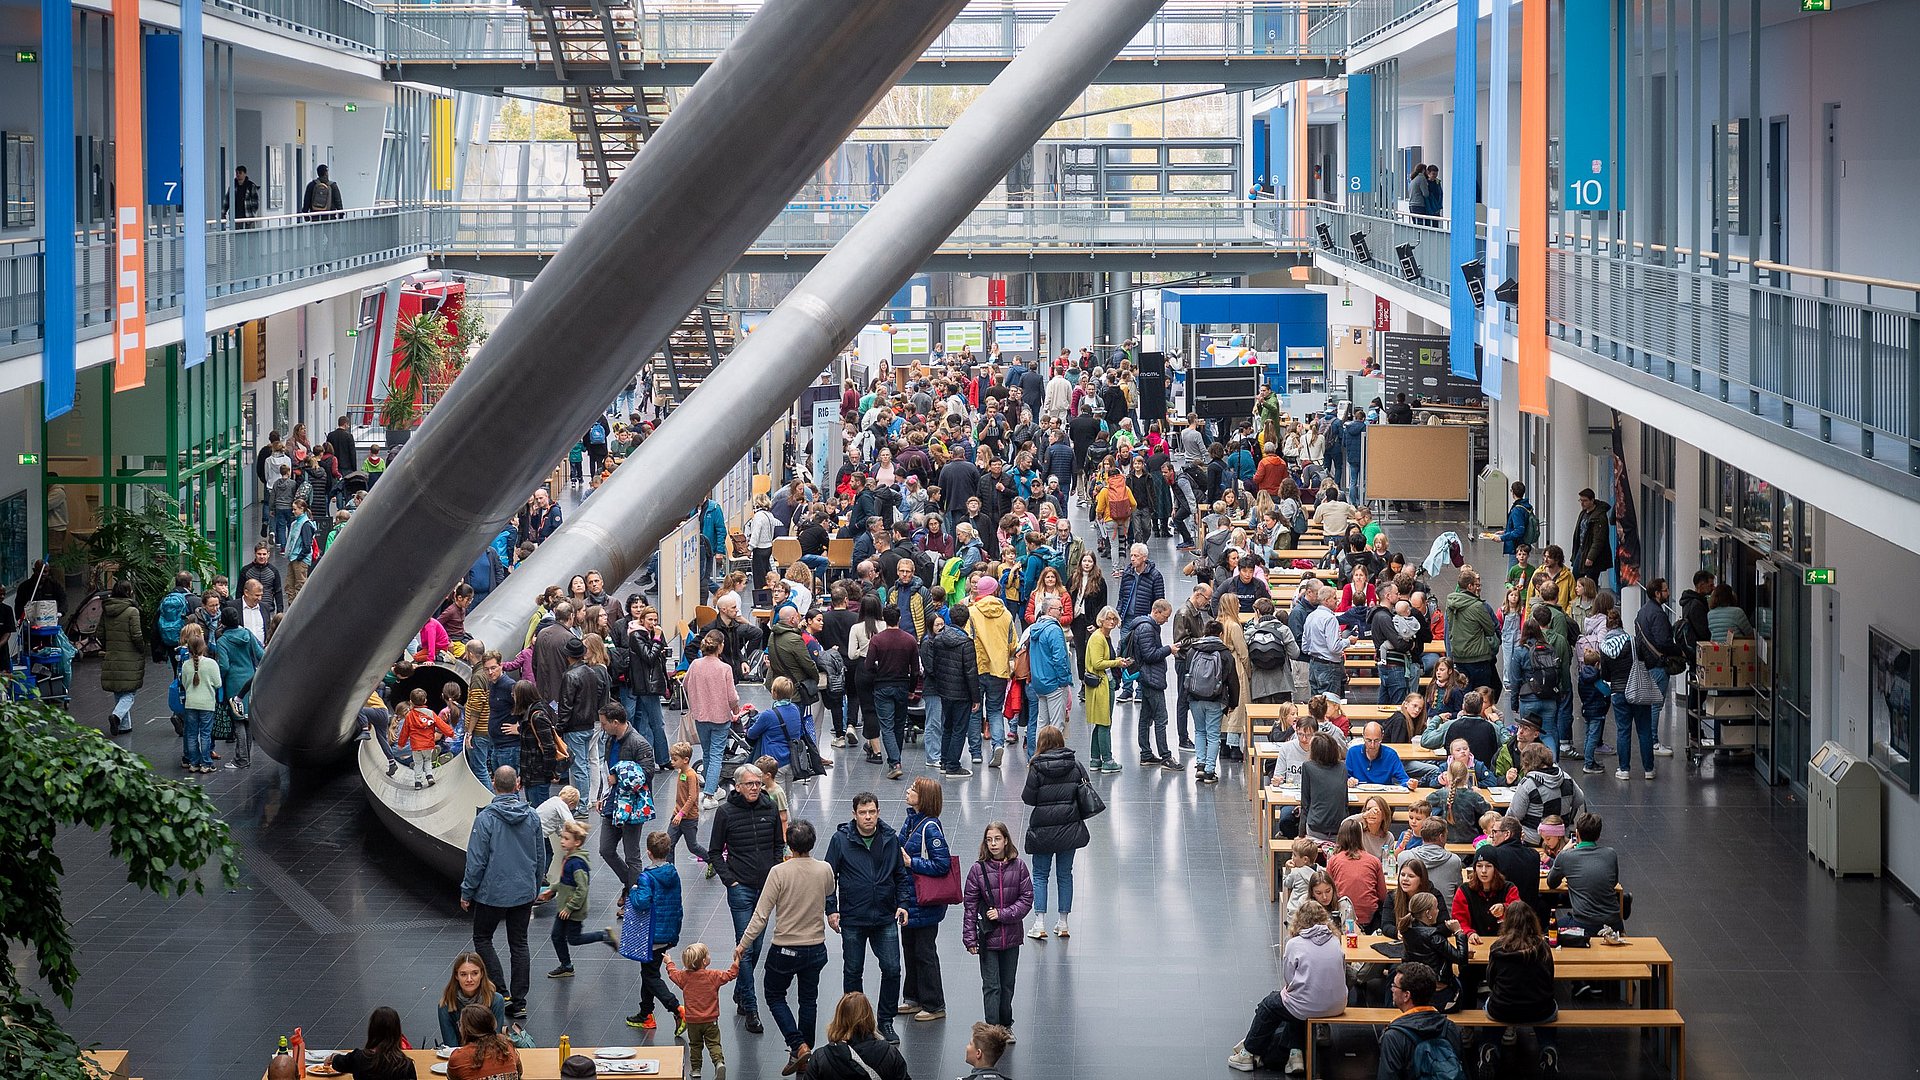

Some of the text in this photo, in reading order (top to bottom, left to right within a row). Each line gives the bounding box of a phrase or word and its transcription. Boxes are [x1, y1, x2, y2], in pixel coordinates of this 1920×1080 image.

[1269, 29, 1276, 40] 6
[1258, 174, 1265, 183] 4
[1272, 175, 1279, 185] 6
[1350, 176, 1361, 191] 8
[163, 182, 178, 202] 7
[1570, 179, 1602, 205] 10
[817, 407, 830, 418] RIG
